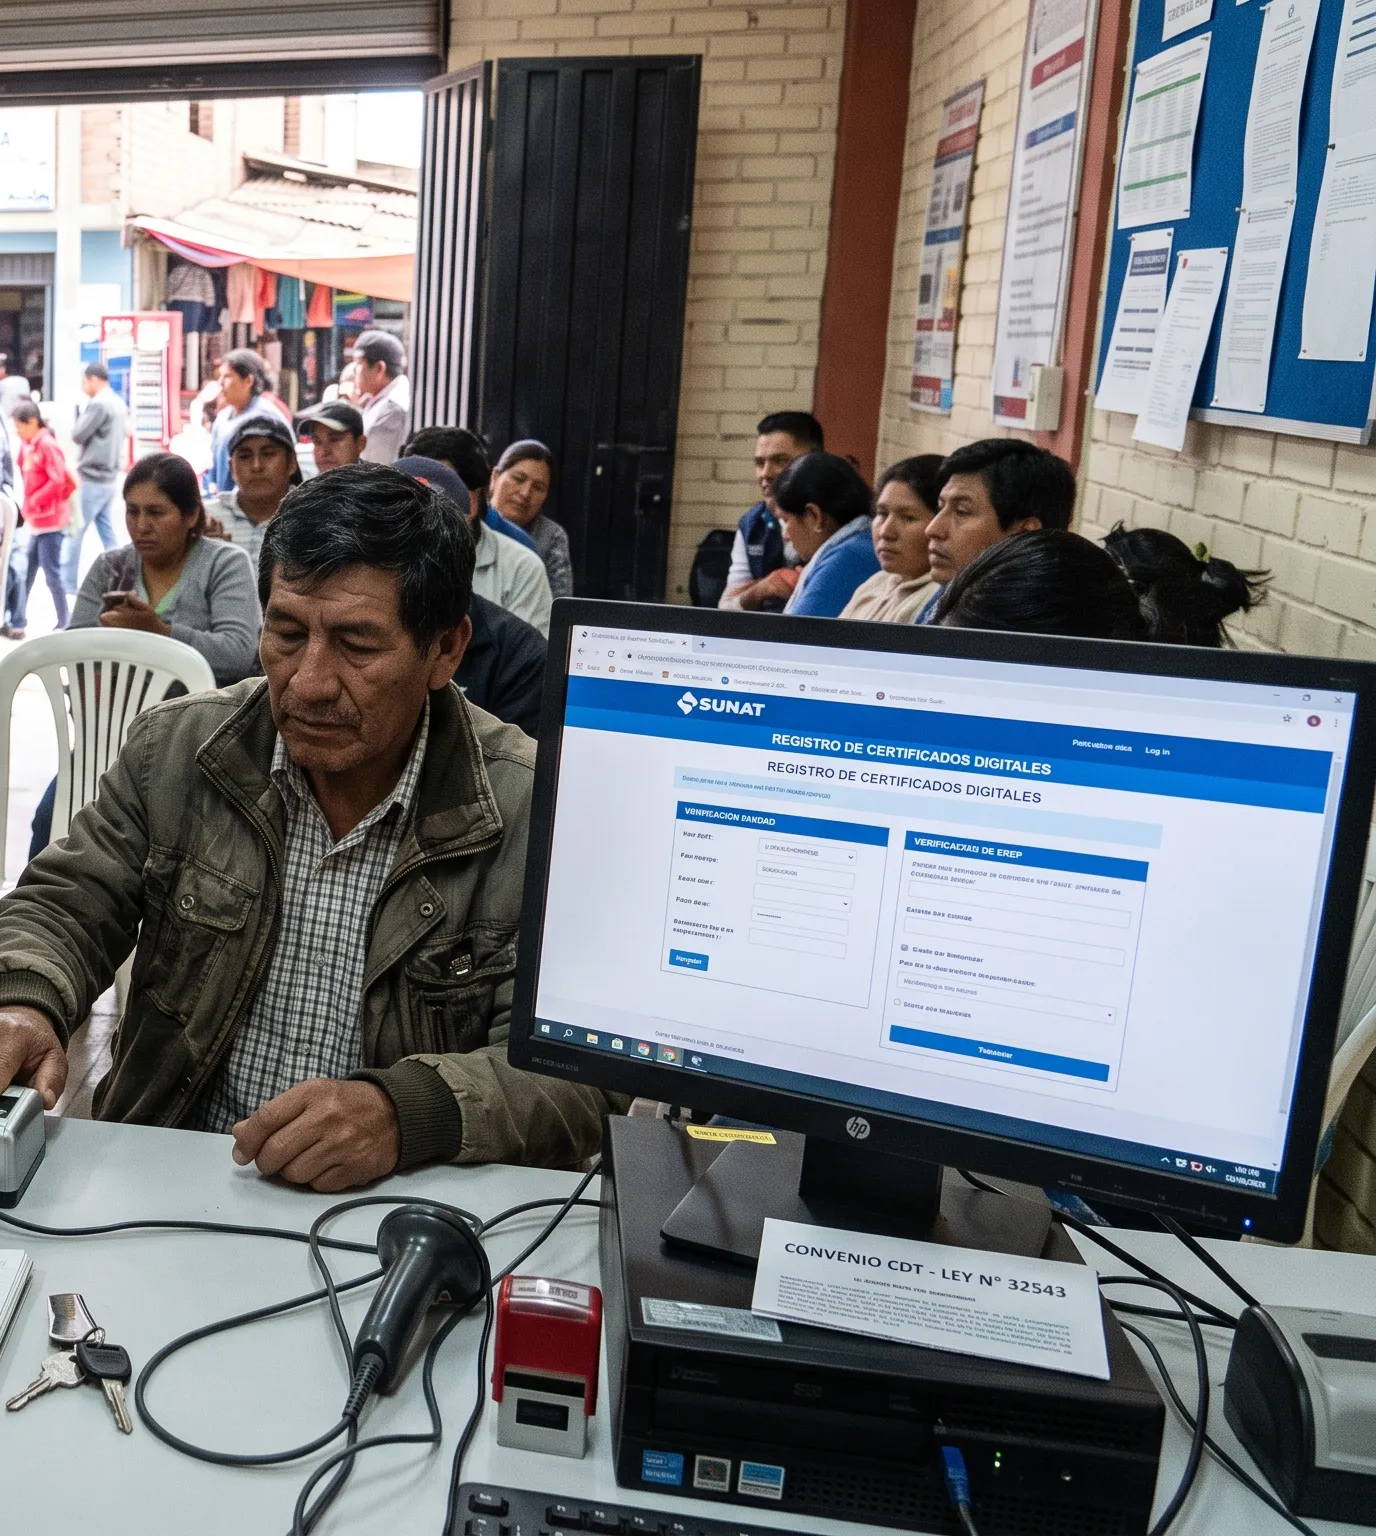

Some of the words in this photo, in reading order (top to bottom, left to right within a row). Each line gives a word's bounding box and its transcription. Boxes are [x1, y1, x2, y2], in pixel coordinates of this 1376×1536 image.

[698, 697, 766, 717] SUNAT
[772, 733, 841, 752] REGISTRO
[844, 742, 864, 755] DE
[866, 744, 971, 766] CERTIFICADOS
[974, 755, 1052, 776] DIGITALES
[1145, 746, 1160, 757] Log
[1162, 747, 1171, 756] in
[767, 761, 835, 779] REGISTRO
[838, 769, 857, 782] DE
[860, 772, 962, 793] CERTIFICADOS
[965, 784, 1042, 804] DIGITALES
[981, 846, 995, 856] DE
[848, 1116, 868, 1138] hp
[784, 1243, 882, 1268] CONVENIO
[887, 1260, 924, 1275] CDT
[941, 1268, 974, 1283] LEY
[979, 1274, 1001, 1287] N°
[1008, 1279, 1067, 1298] 32543
